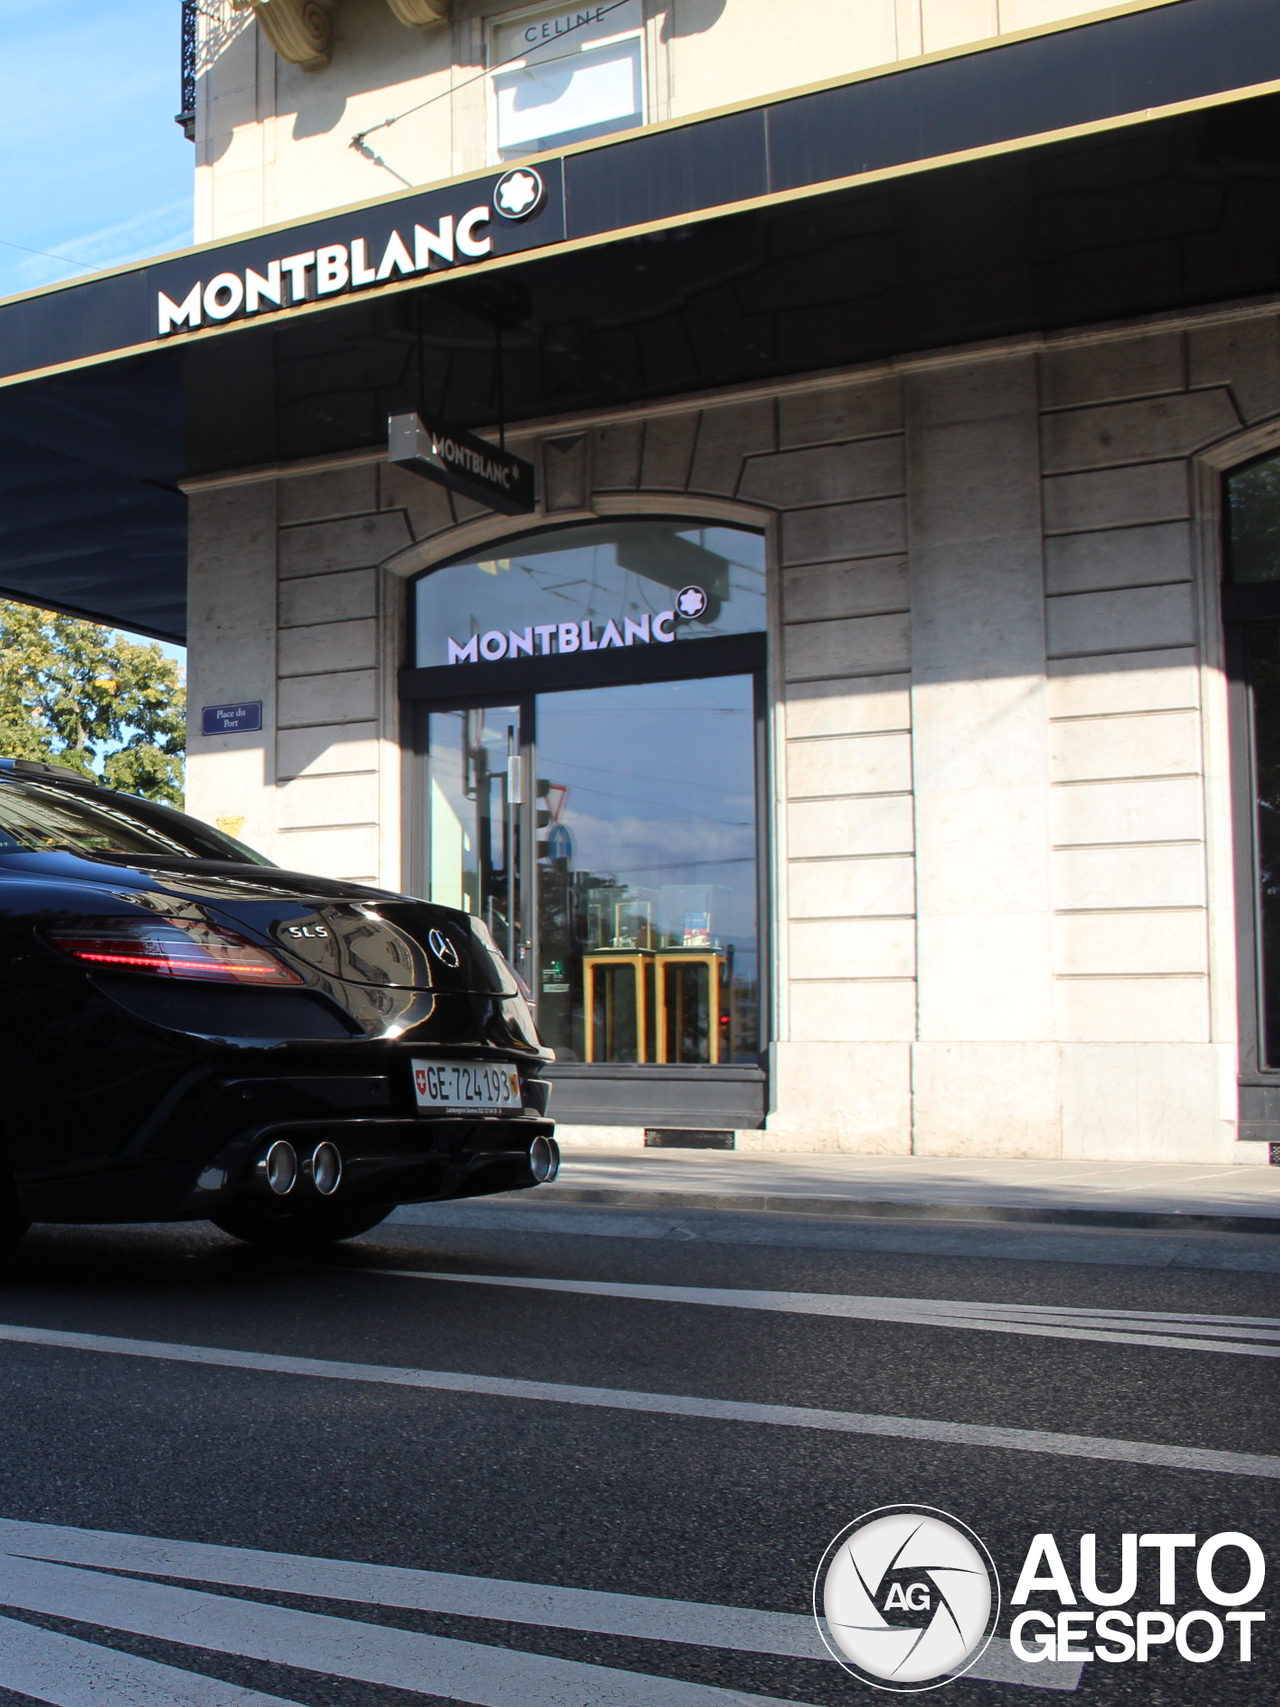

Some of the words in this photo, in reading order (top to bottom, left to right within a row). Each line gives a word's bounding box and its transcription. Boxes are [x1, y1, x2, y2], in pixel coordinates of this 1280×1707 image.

[524, 7, 606, 42] CELINE
[157, 205, 493, 335] MONTBLANC
[432, 432, 511, 489] MONTBLANC
[447, 610, 677, 665] MONTBLANC
[216, 710, 234, 719] Place
[236, 708, 246, 717] du
[224, 719, 238, 728] Port
[287, 926, 328, 938] SLS
